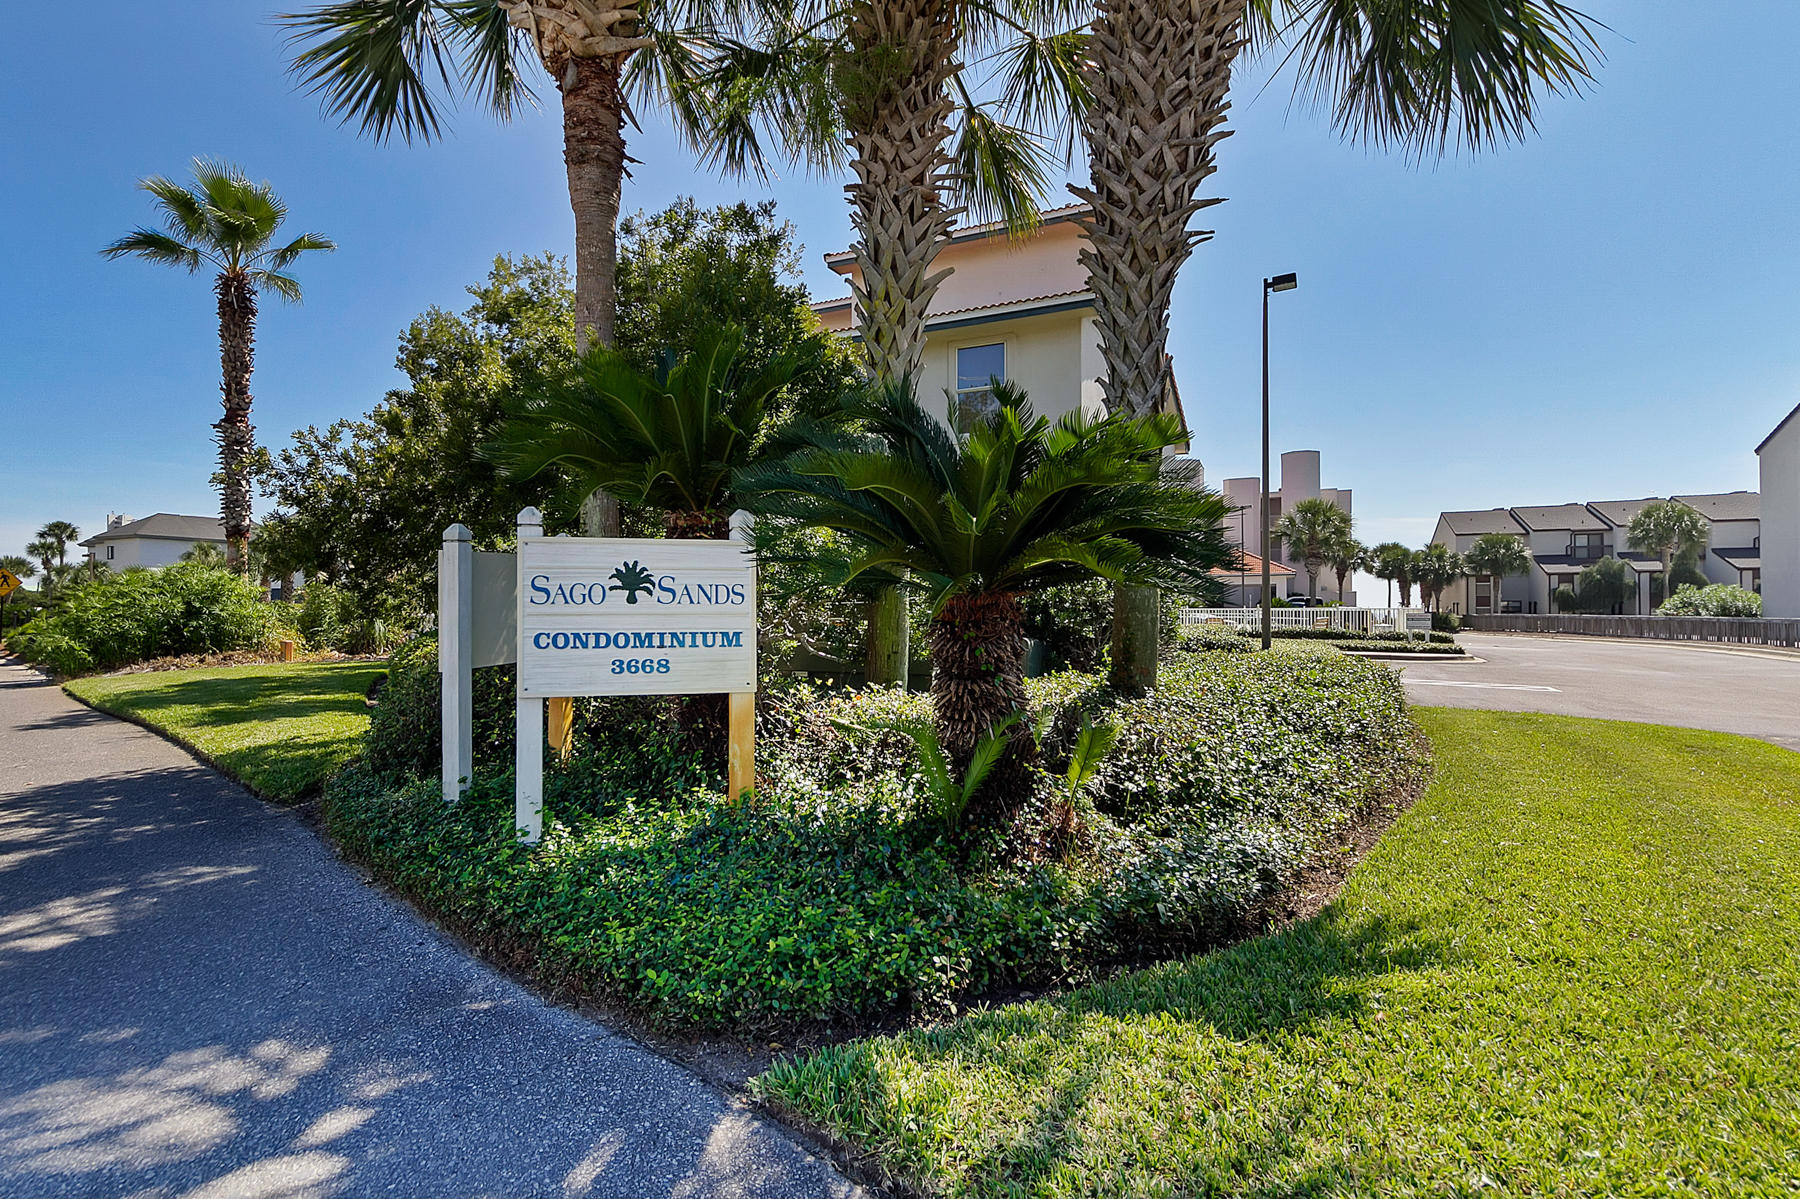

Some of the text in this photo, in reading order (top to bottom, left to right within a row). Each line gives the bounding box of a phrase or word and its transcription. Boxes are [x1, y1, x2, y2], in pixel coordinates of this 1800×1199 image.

[529, 575, 745, 605] SAGO SANDS
[533, 631, 743, 650] CONDOMINIUM
[610, 658, 671, 675] 3668
